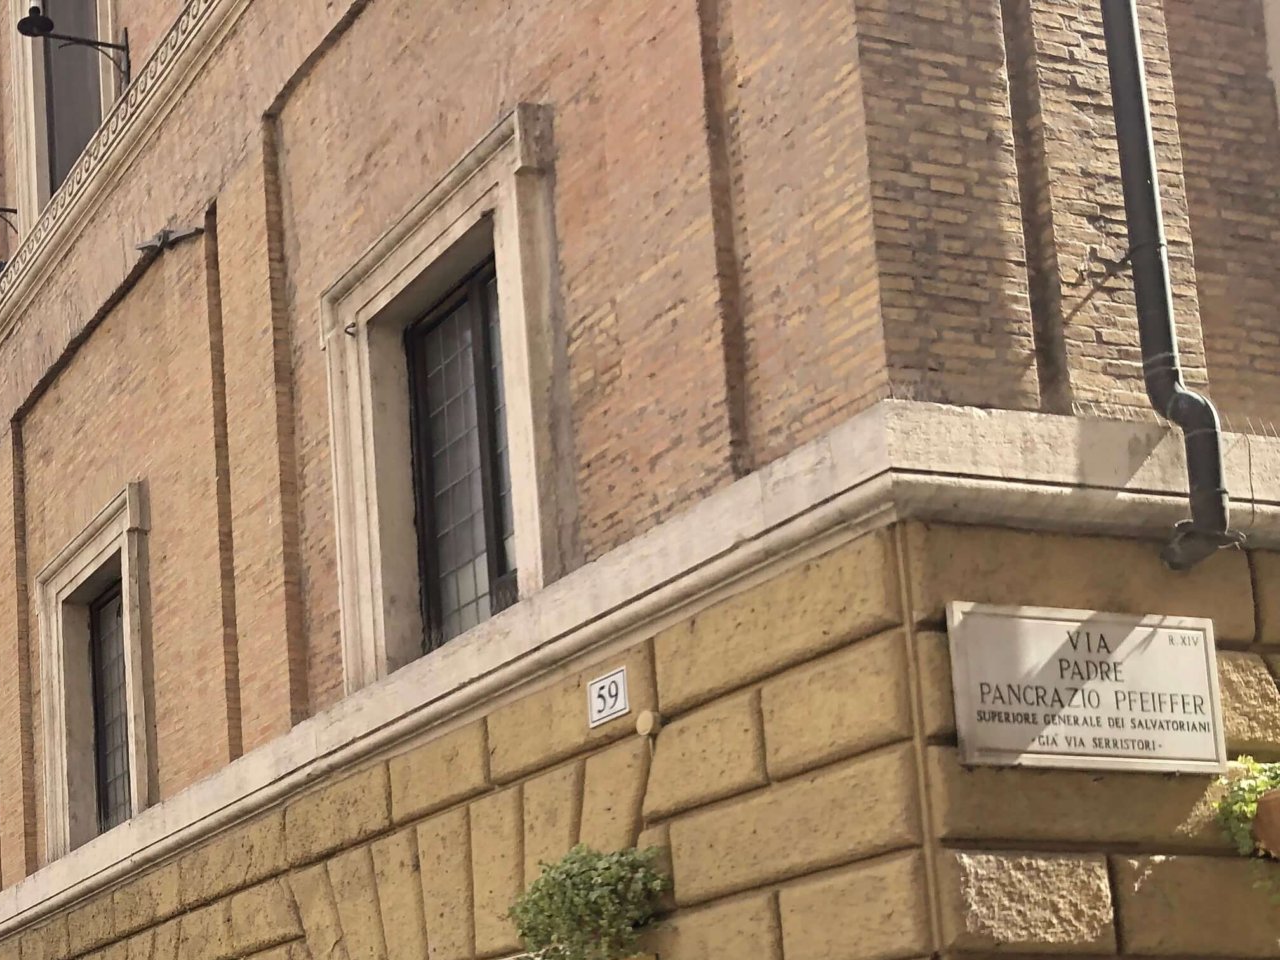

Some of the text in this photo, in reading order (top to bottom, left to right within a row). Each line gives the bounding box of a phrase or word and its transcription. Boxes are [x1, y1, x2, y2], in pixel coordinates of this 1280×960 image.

[1066, 630, 1111, 654] VIA
[1058, 658, 1125, 683] PADRE
[596, 680, 619, 714] 59
[978, 682, 1207, 715] PANCRAZIO PFEIFFER
[976, 709, 1211, 733] SUPERIORE GENERALE DEI SALVATORIANI
[1064, 735, 1085, 748] VIA
[1092, 737, 1157, 751] SERRISTORI
